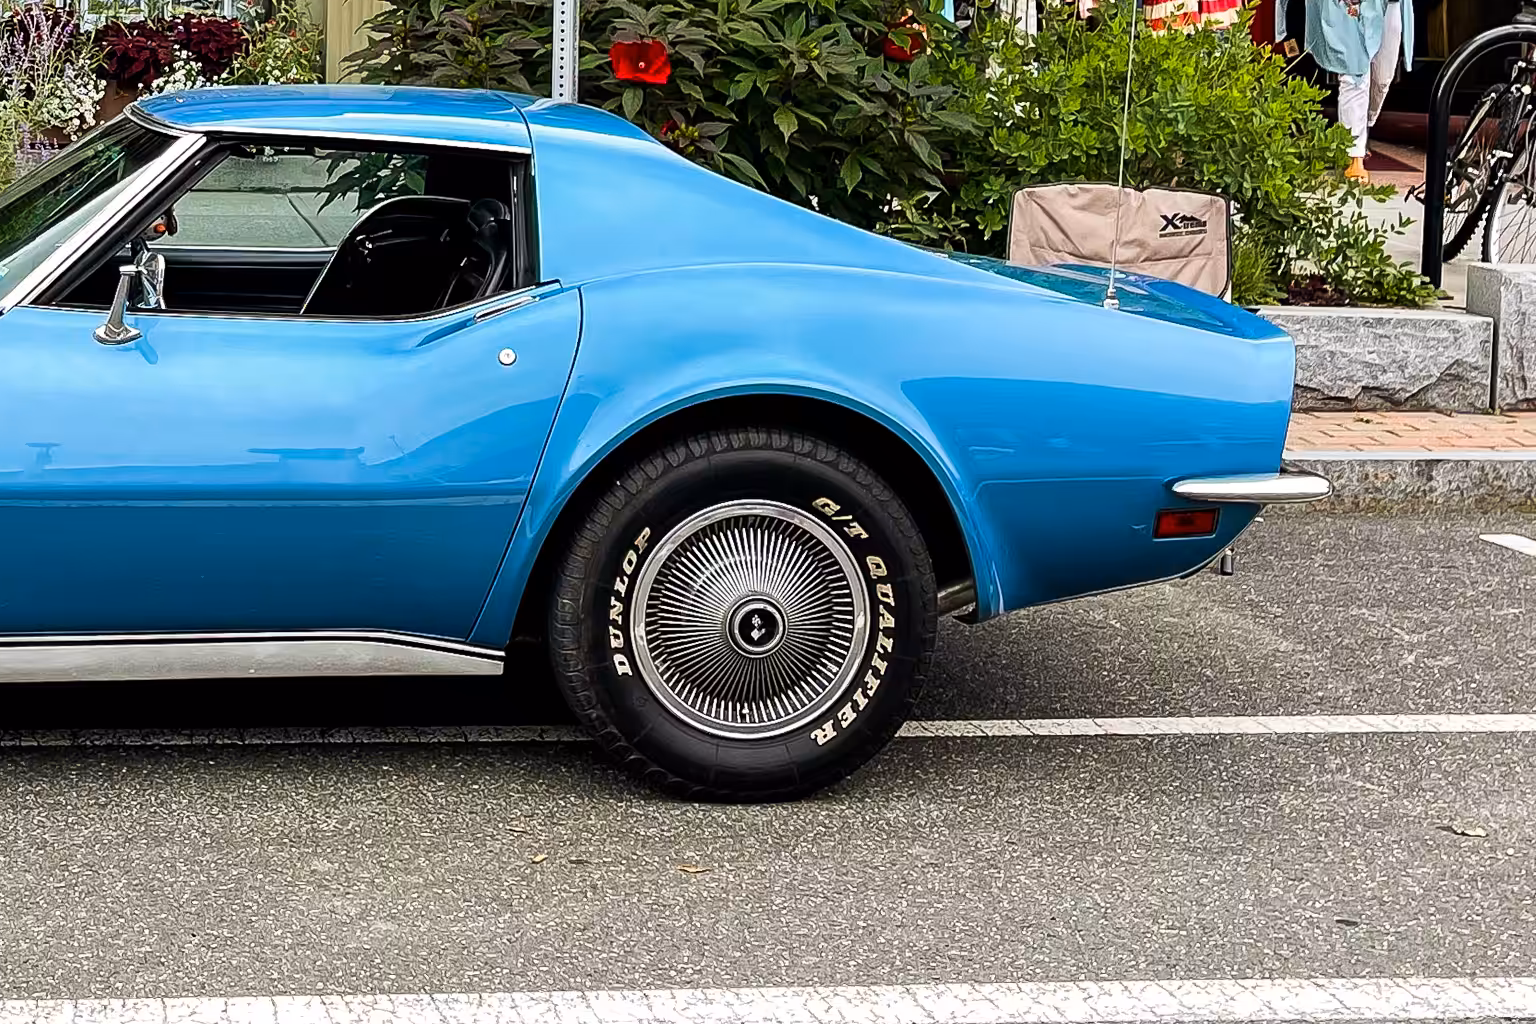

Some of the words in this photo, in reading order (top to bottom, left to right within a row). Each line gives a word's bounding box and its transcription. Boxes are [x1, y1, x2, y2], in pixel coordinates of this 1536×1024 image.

[812, 496, 870, 540] G/T
[608, 526, 651, 677] DUNLOP
[810, 554, 896, 746] QUALIFIER
